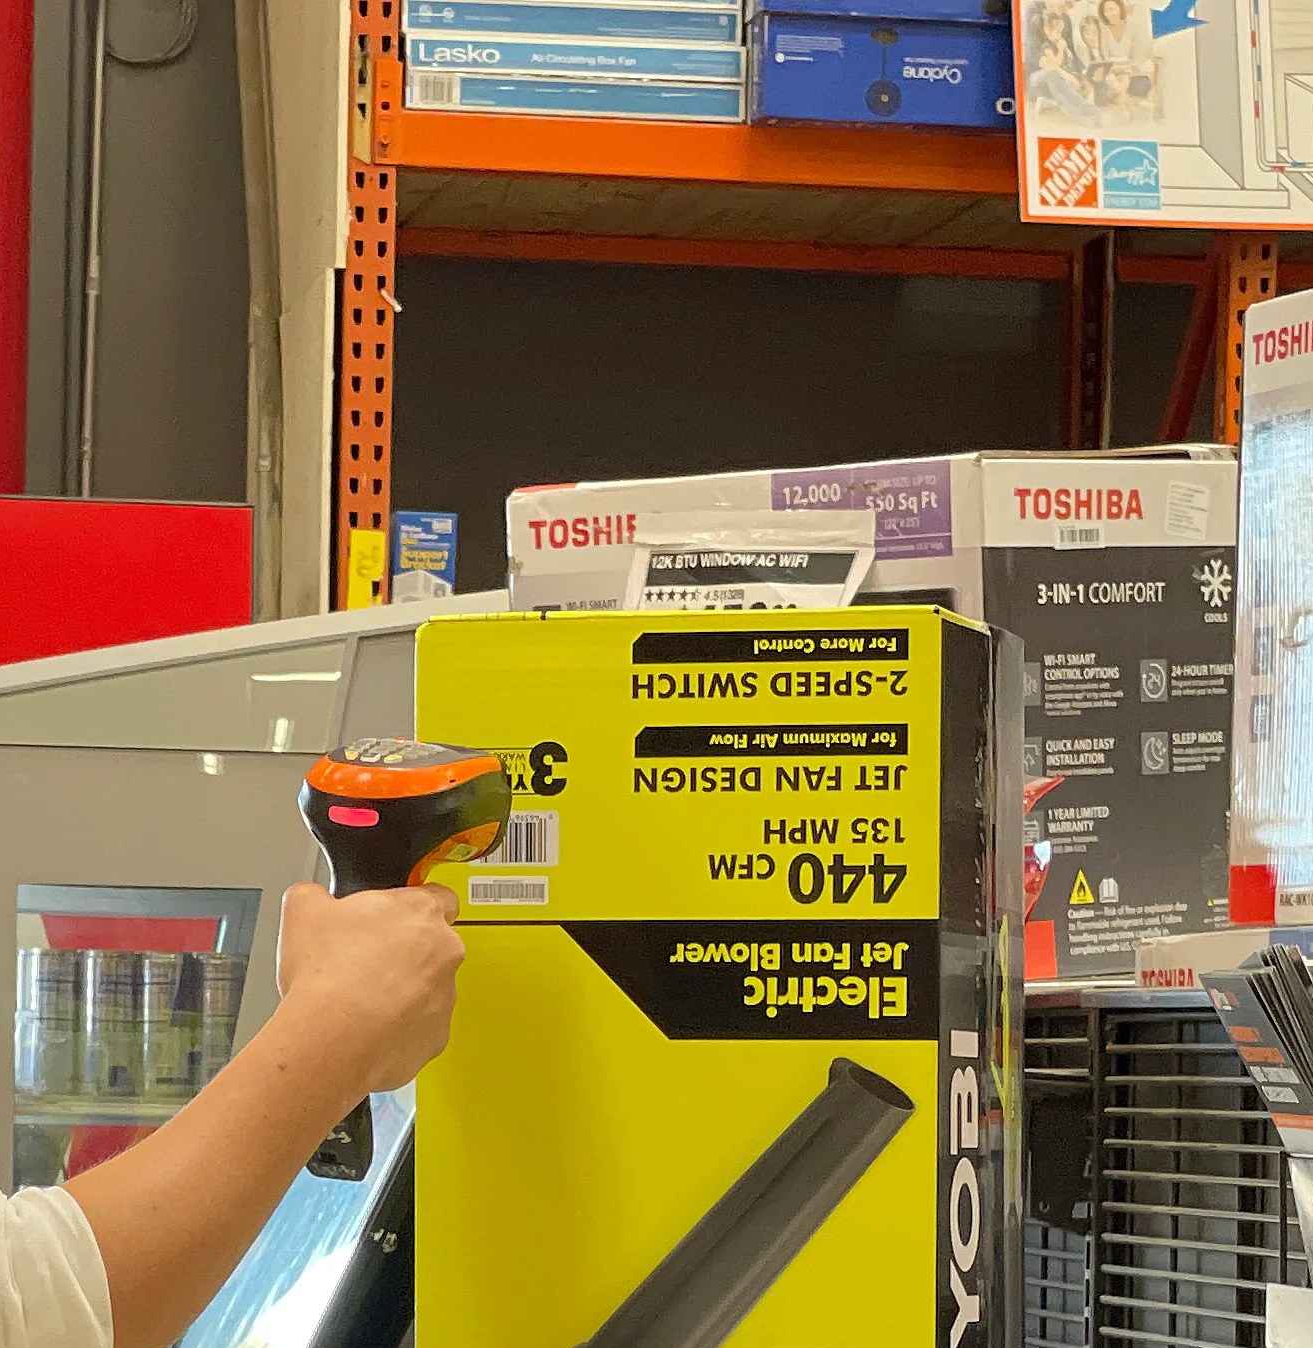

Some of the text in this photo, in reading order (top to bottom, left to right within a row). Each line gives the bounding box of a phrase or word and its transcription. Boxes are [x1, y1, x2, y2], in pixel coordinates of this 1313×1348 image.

[419, 44, 501, 64] Lasko
[903, 66, 961, 84] Cyclone
[1039, 142, 1092, 206] HOME
[783, 483, 841, 507] 12,000
[898, 494, 917, 516] Sq
[919, 493, 937, 509] Ft
[1014, 488, 1144, 520] TOSHIBA
[651, 552, 809, 569] 12K BTU WINDOW AC WIFI
[1037, 582, 1166, 605] 3-IN-1 COMFORT
[753, 638, 897, 654] For More Control
[632, 670, 908, 699] 2-SPEED SWITCH
[1044, 666, 1120, 680] CONTROL OPTIONS
[709, 732, 897, 749] for Maximum Air Flow
[1046, 738, 1116, 751] QUICK AND EASY
[1172, 731, 1223, 744] SLEEP MODE
[1046, 753, 1105, 766] INSTALLATION
[633, 765, 909, 792] JET FAN DESIGN
[764, 818, 905, 844] 135 MPH
[709, 852, 907, 904] 440 CFM
[670, 942, 909, 972] Jet Fan Blower
[743, 975, 907, 1019] Electric
